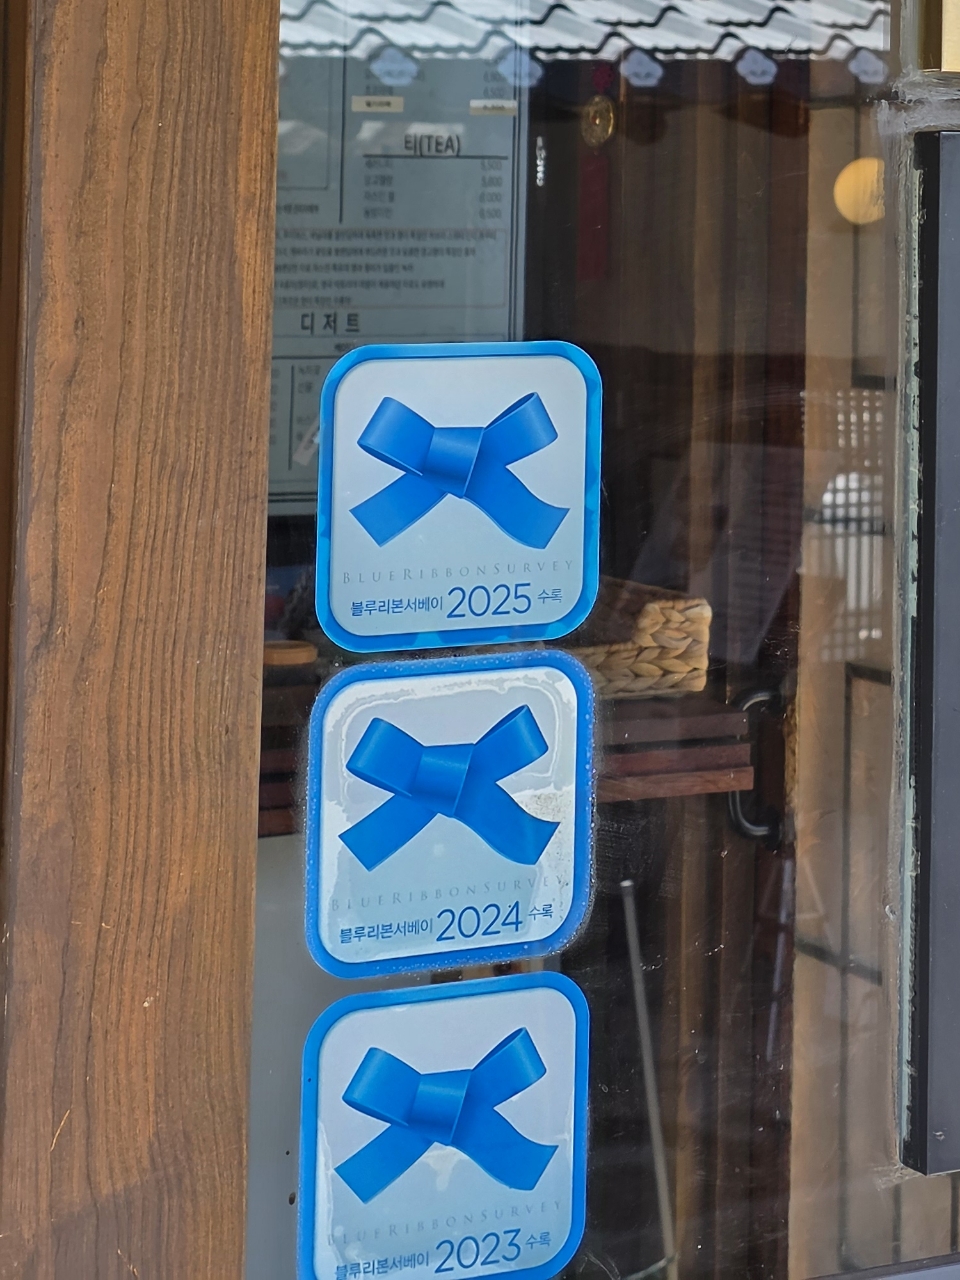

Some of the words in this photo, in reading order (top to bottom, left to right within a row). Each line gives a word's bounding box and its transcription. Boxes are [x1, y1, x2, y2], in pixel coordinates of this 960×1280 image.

[350, 595, 444, 617] 블루리본서베이
[446, 582, 533, 619] 2025
[537, 587, 564, 605] 수록
[339, 916, 434, 944] 블루리본서베이
[435, 900, 523, 942] 2024
[528, 903, 554, 922] 수록
[434, 1227, 522, 1274] 2023
[525, 1231, 552, 1249] 수록
